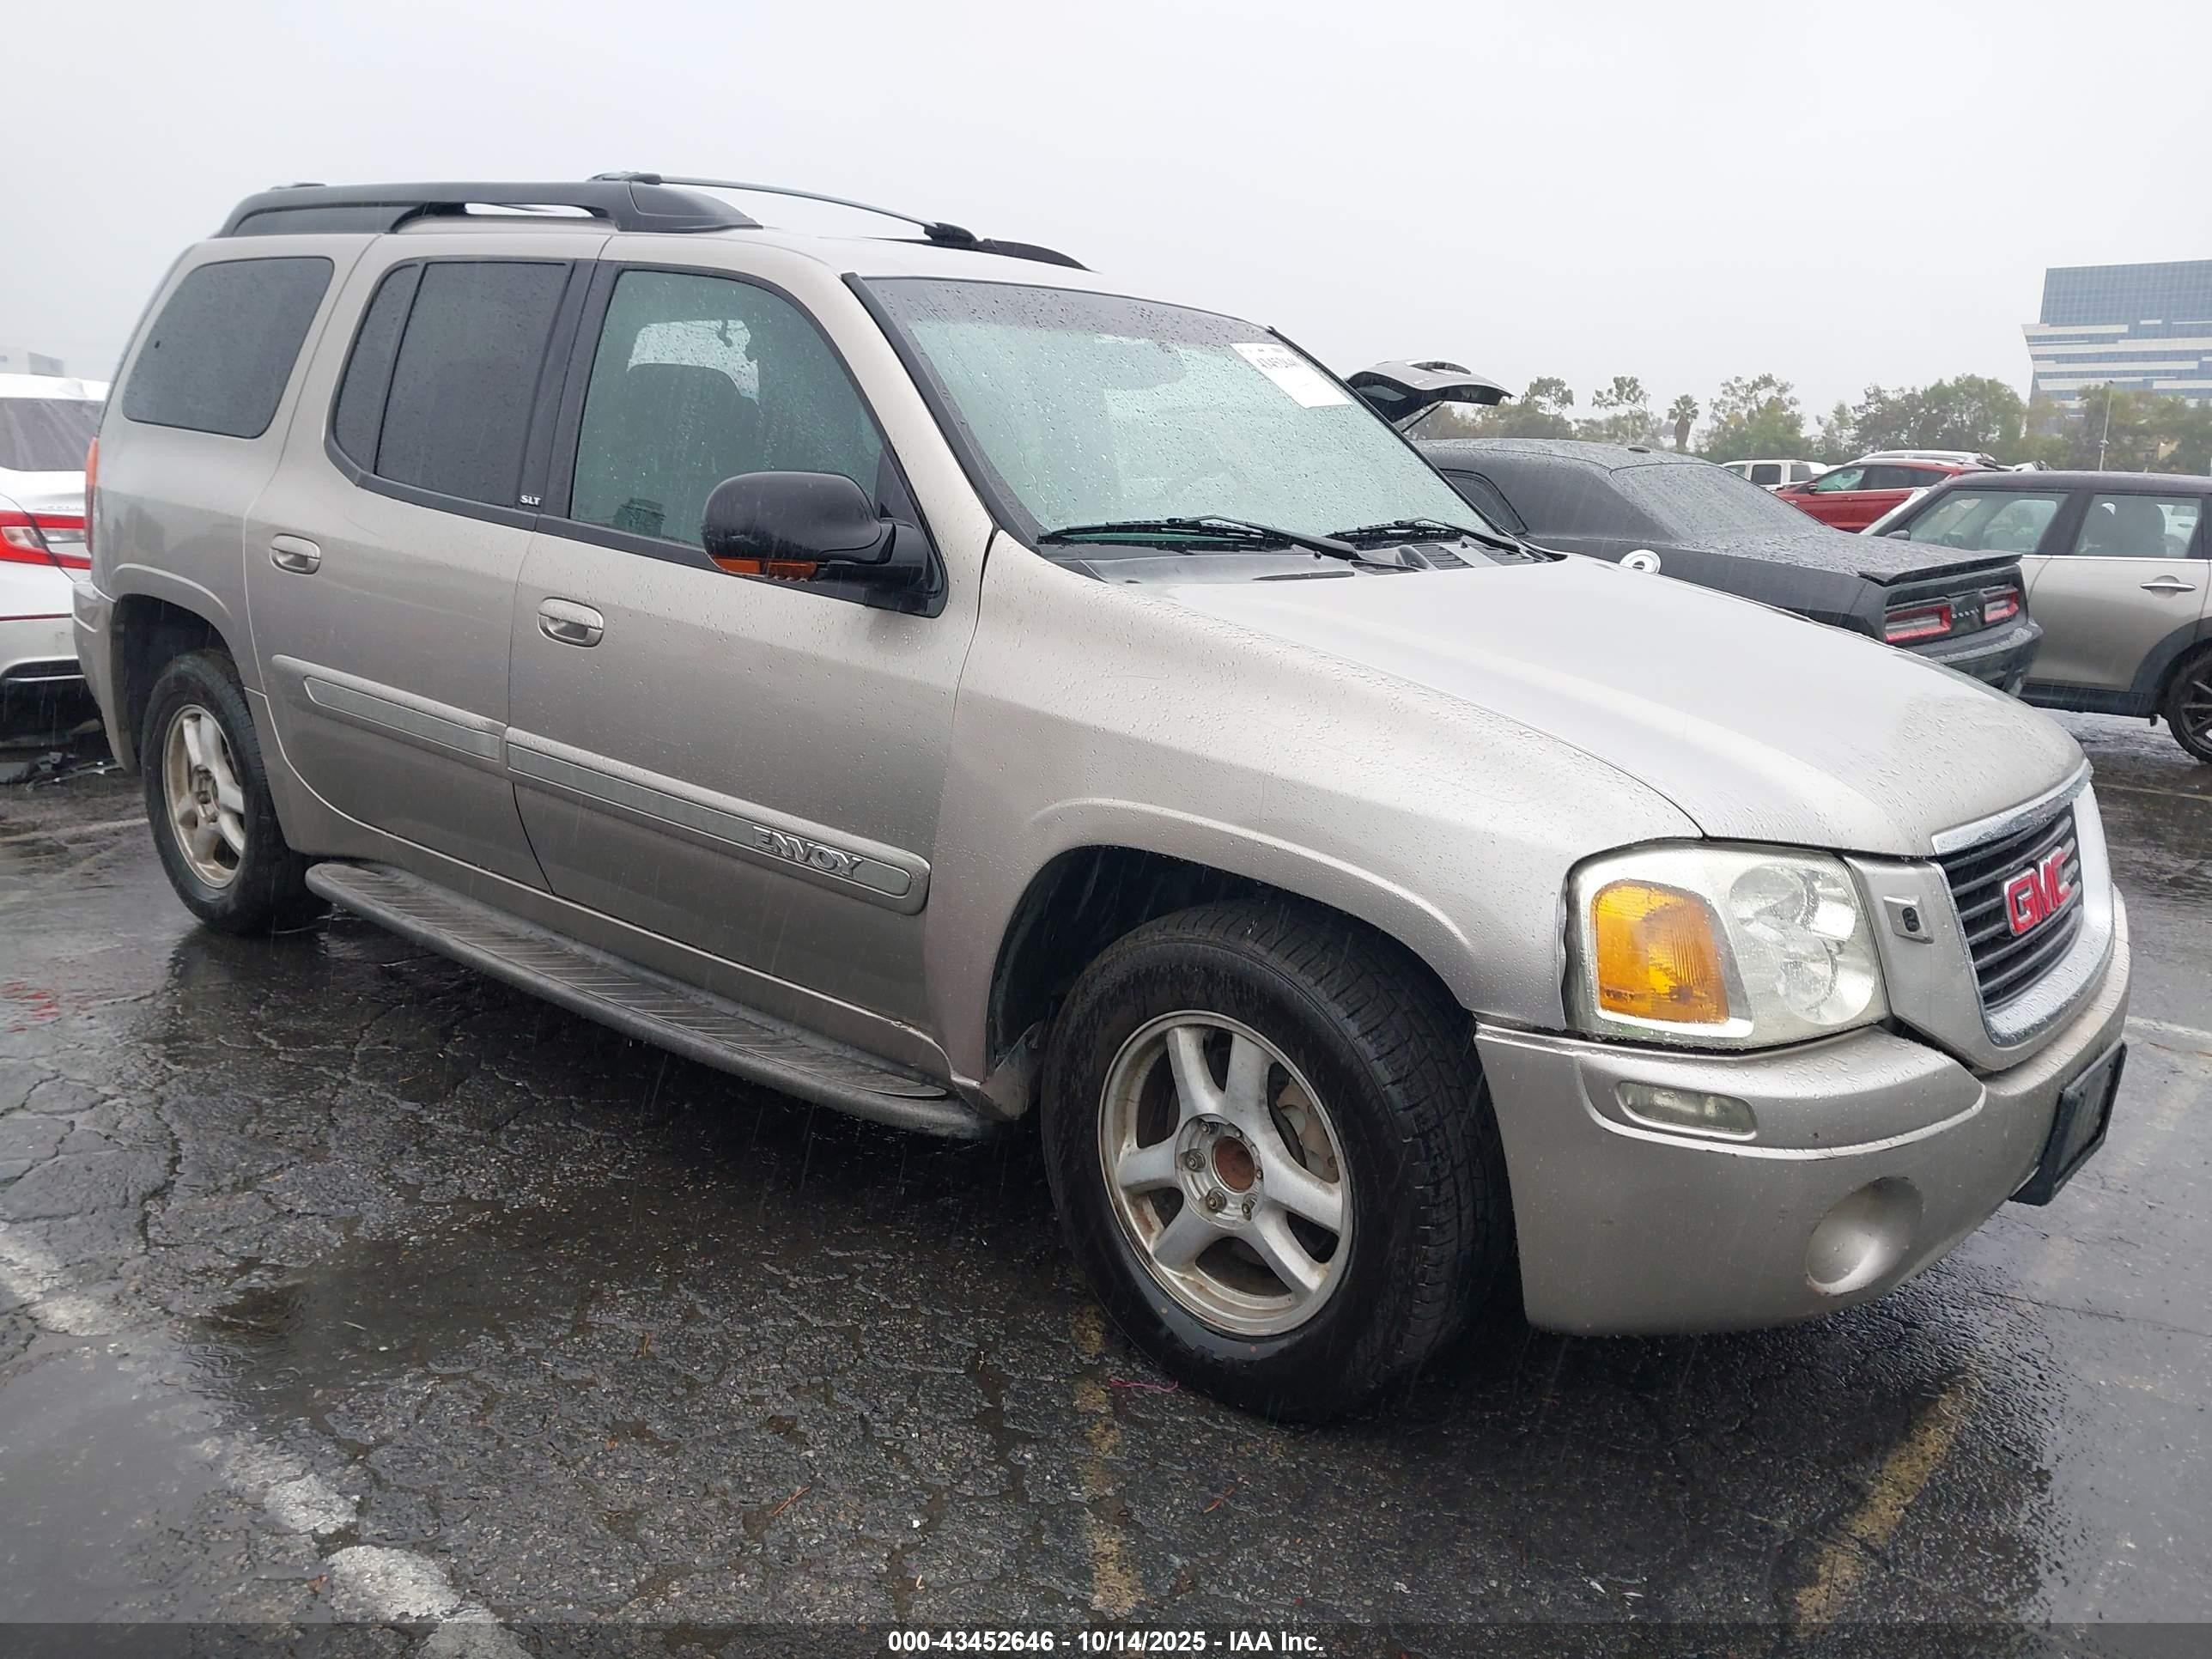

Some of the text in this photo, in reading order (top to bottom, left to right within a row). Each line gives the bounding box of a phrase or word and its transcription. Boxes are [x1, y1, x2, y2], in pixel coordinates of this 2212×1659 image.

[520, 495, 542, 506] SLT
[753, 825, 863, 877] ENVOY
[2003, 846, 2072, 936] GMC
